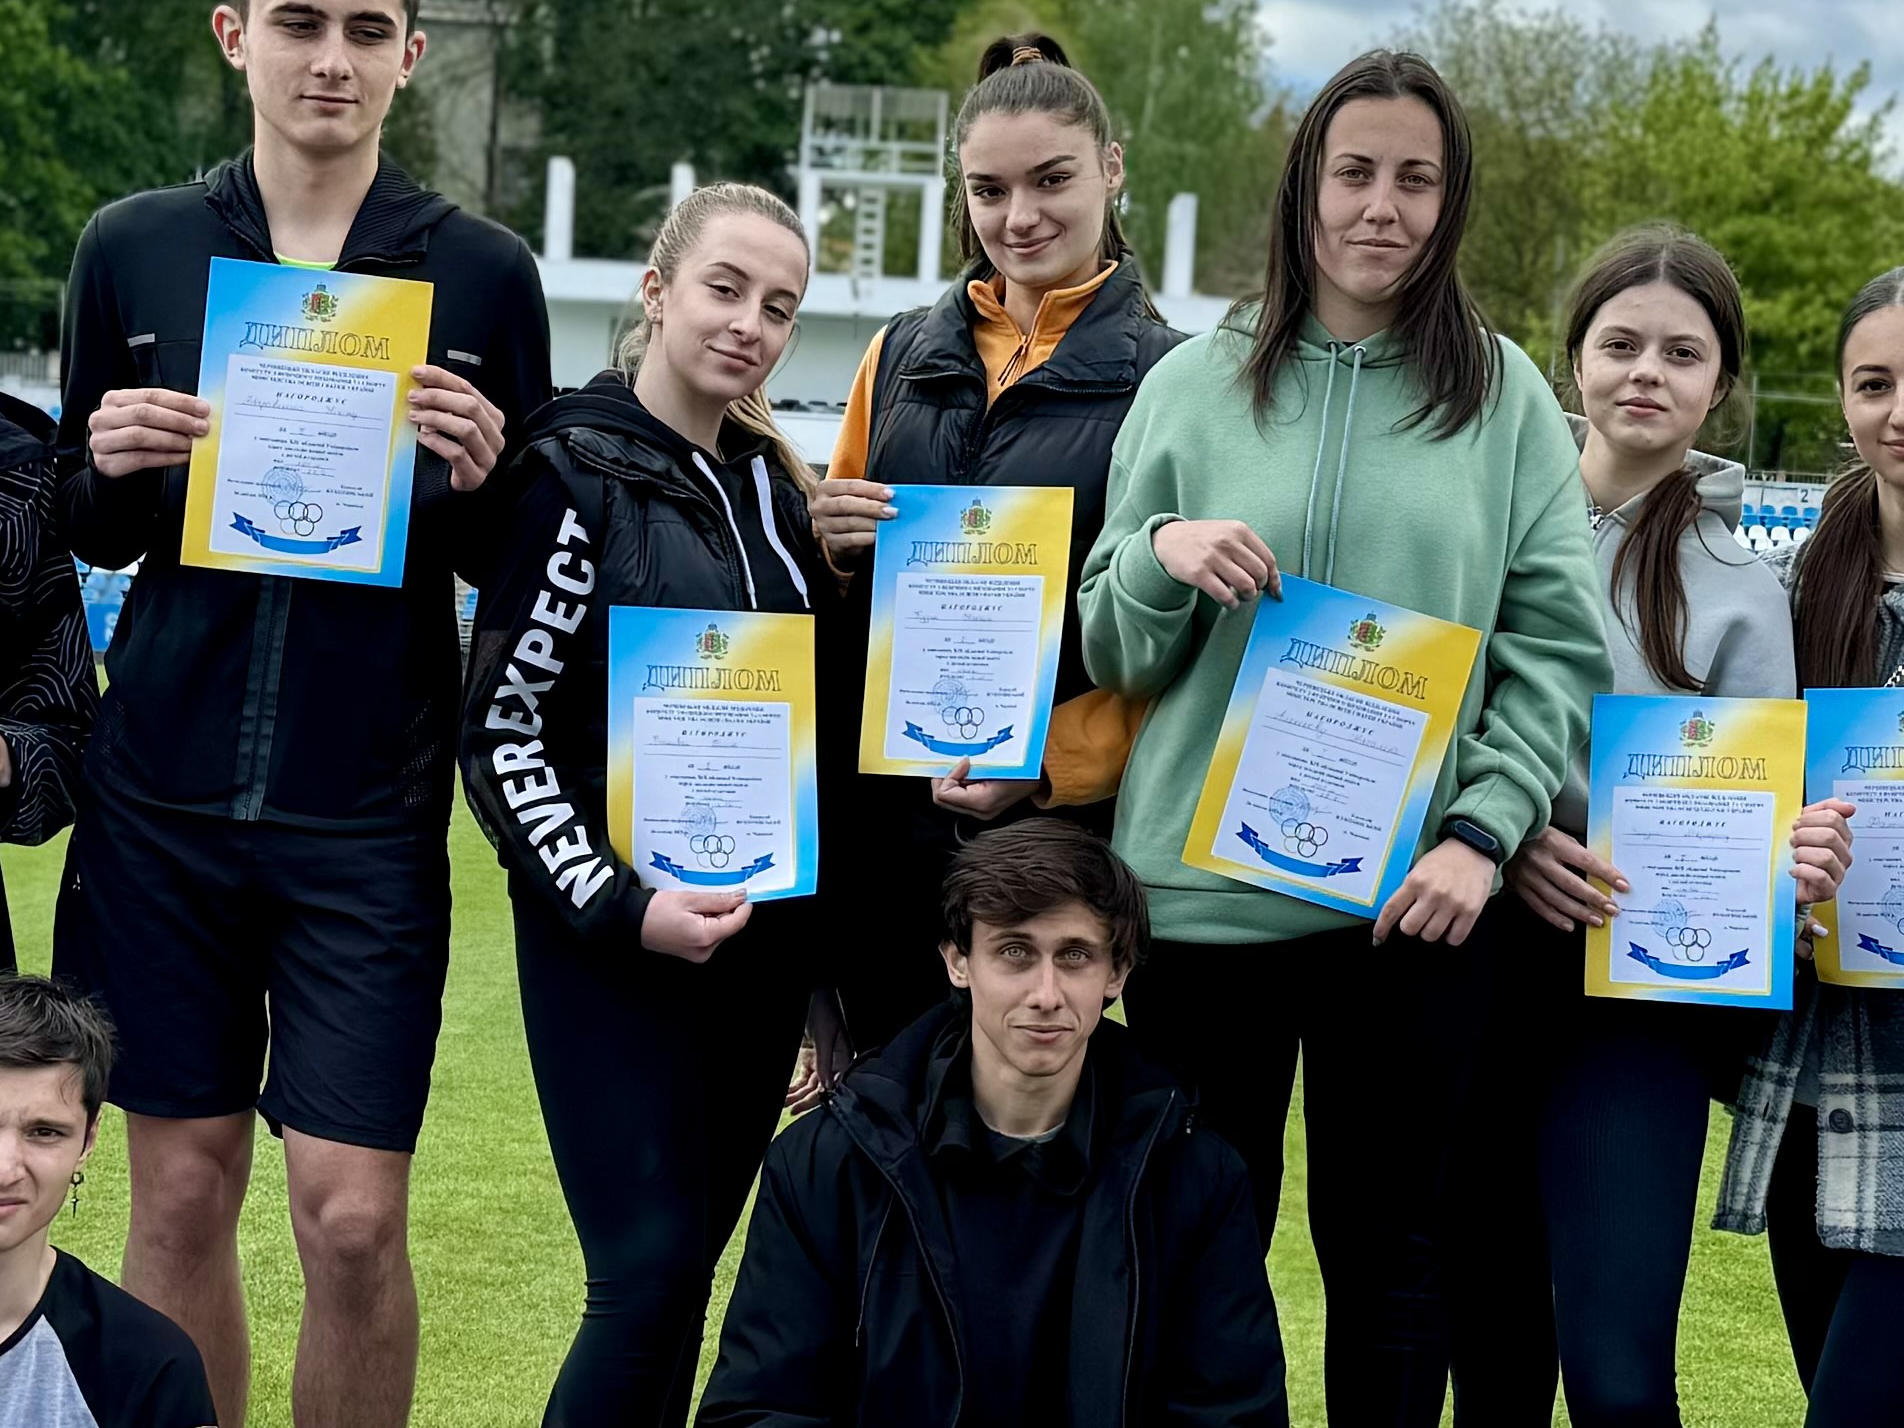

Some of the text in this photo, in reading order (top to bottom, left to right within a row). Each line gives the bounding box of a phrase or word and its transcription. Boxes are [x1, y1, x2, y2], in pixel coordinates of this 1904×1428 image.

[239, 321, 391, 361] ДИПЛОМ
[905, 540, 1039, 567] ДИПЛОМ
[642, 664, 782, 692] ДИПЛОМ
[1279, 637, 1429, 701] ДИПЛОМ
[485, 508, 615, 909] NEVER EXPECT
[1622, 752, 1768, 781] ДИПЛОМ
